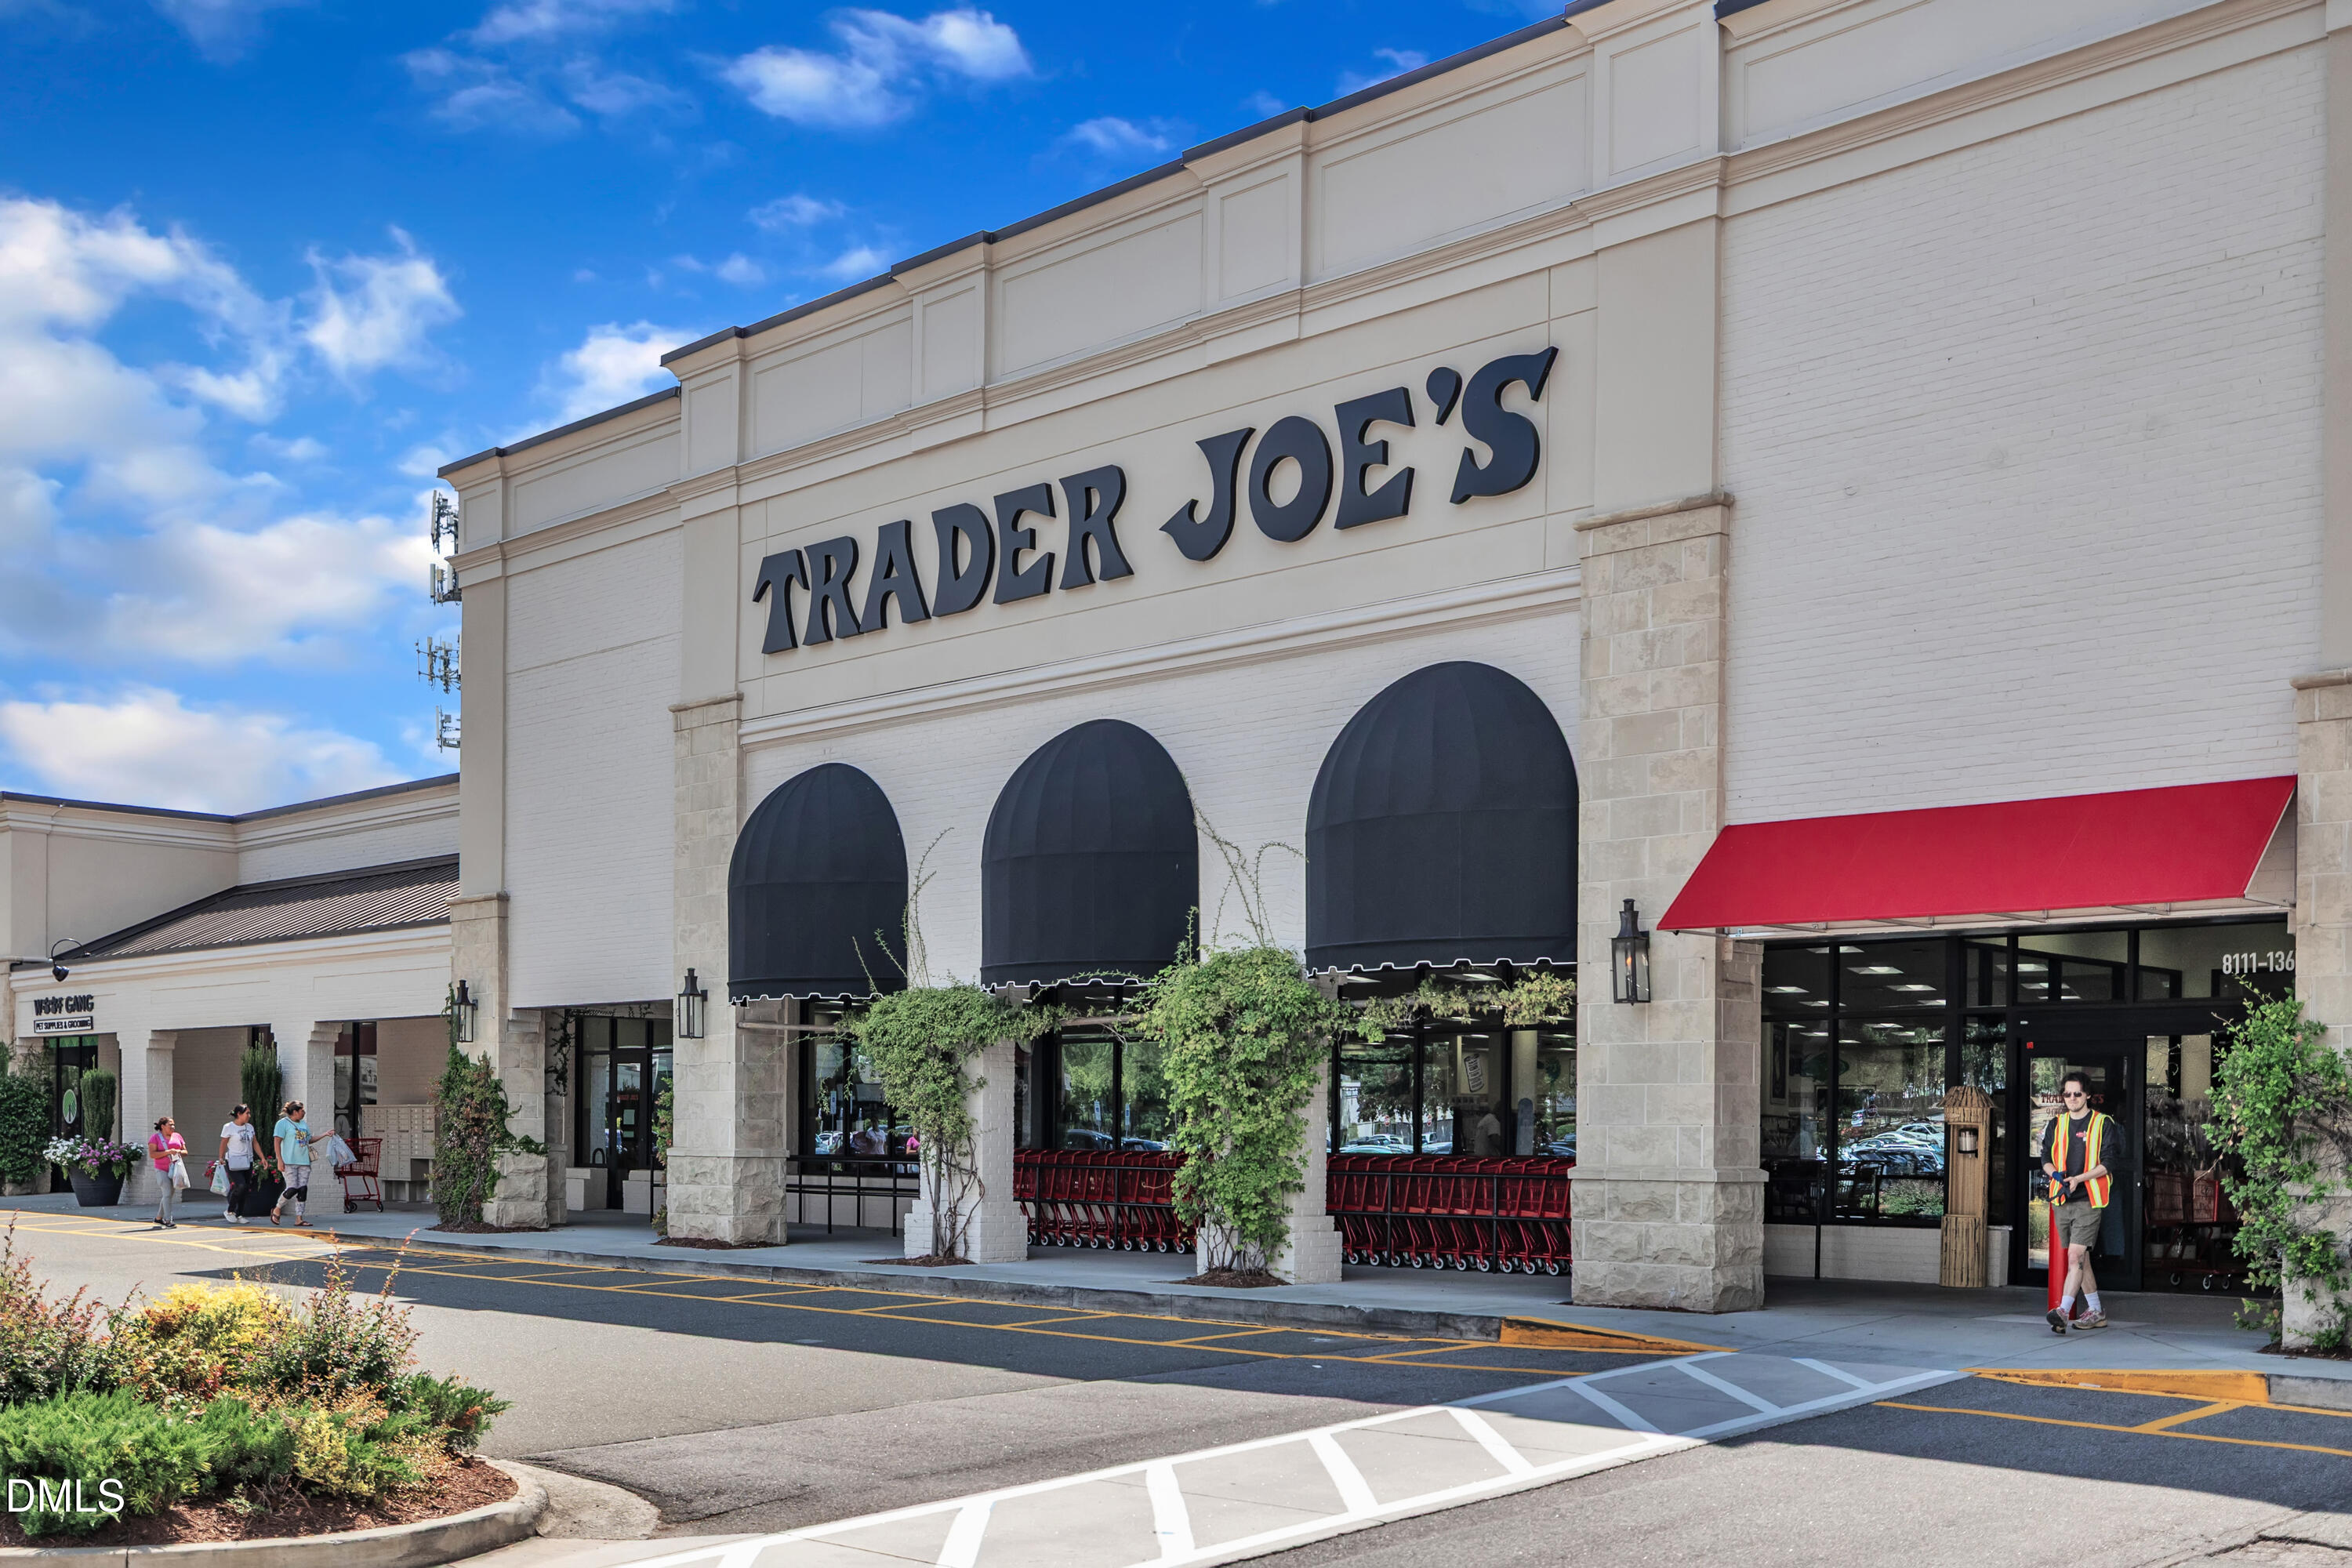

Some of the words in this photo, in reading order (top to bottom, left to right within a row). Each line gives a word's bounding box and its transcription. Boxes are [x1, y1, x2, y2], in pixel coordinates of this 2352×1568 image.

[753, 465, 1134, 654] TRADER
[1160, 346, 1558, 562] JOE'S
[2222, 950, 2295, 975] 8111-136
[65, 994, 94, 1013] GANG
